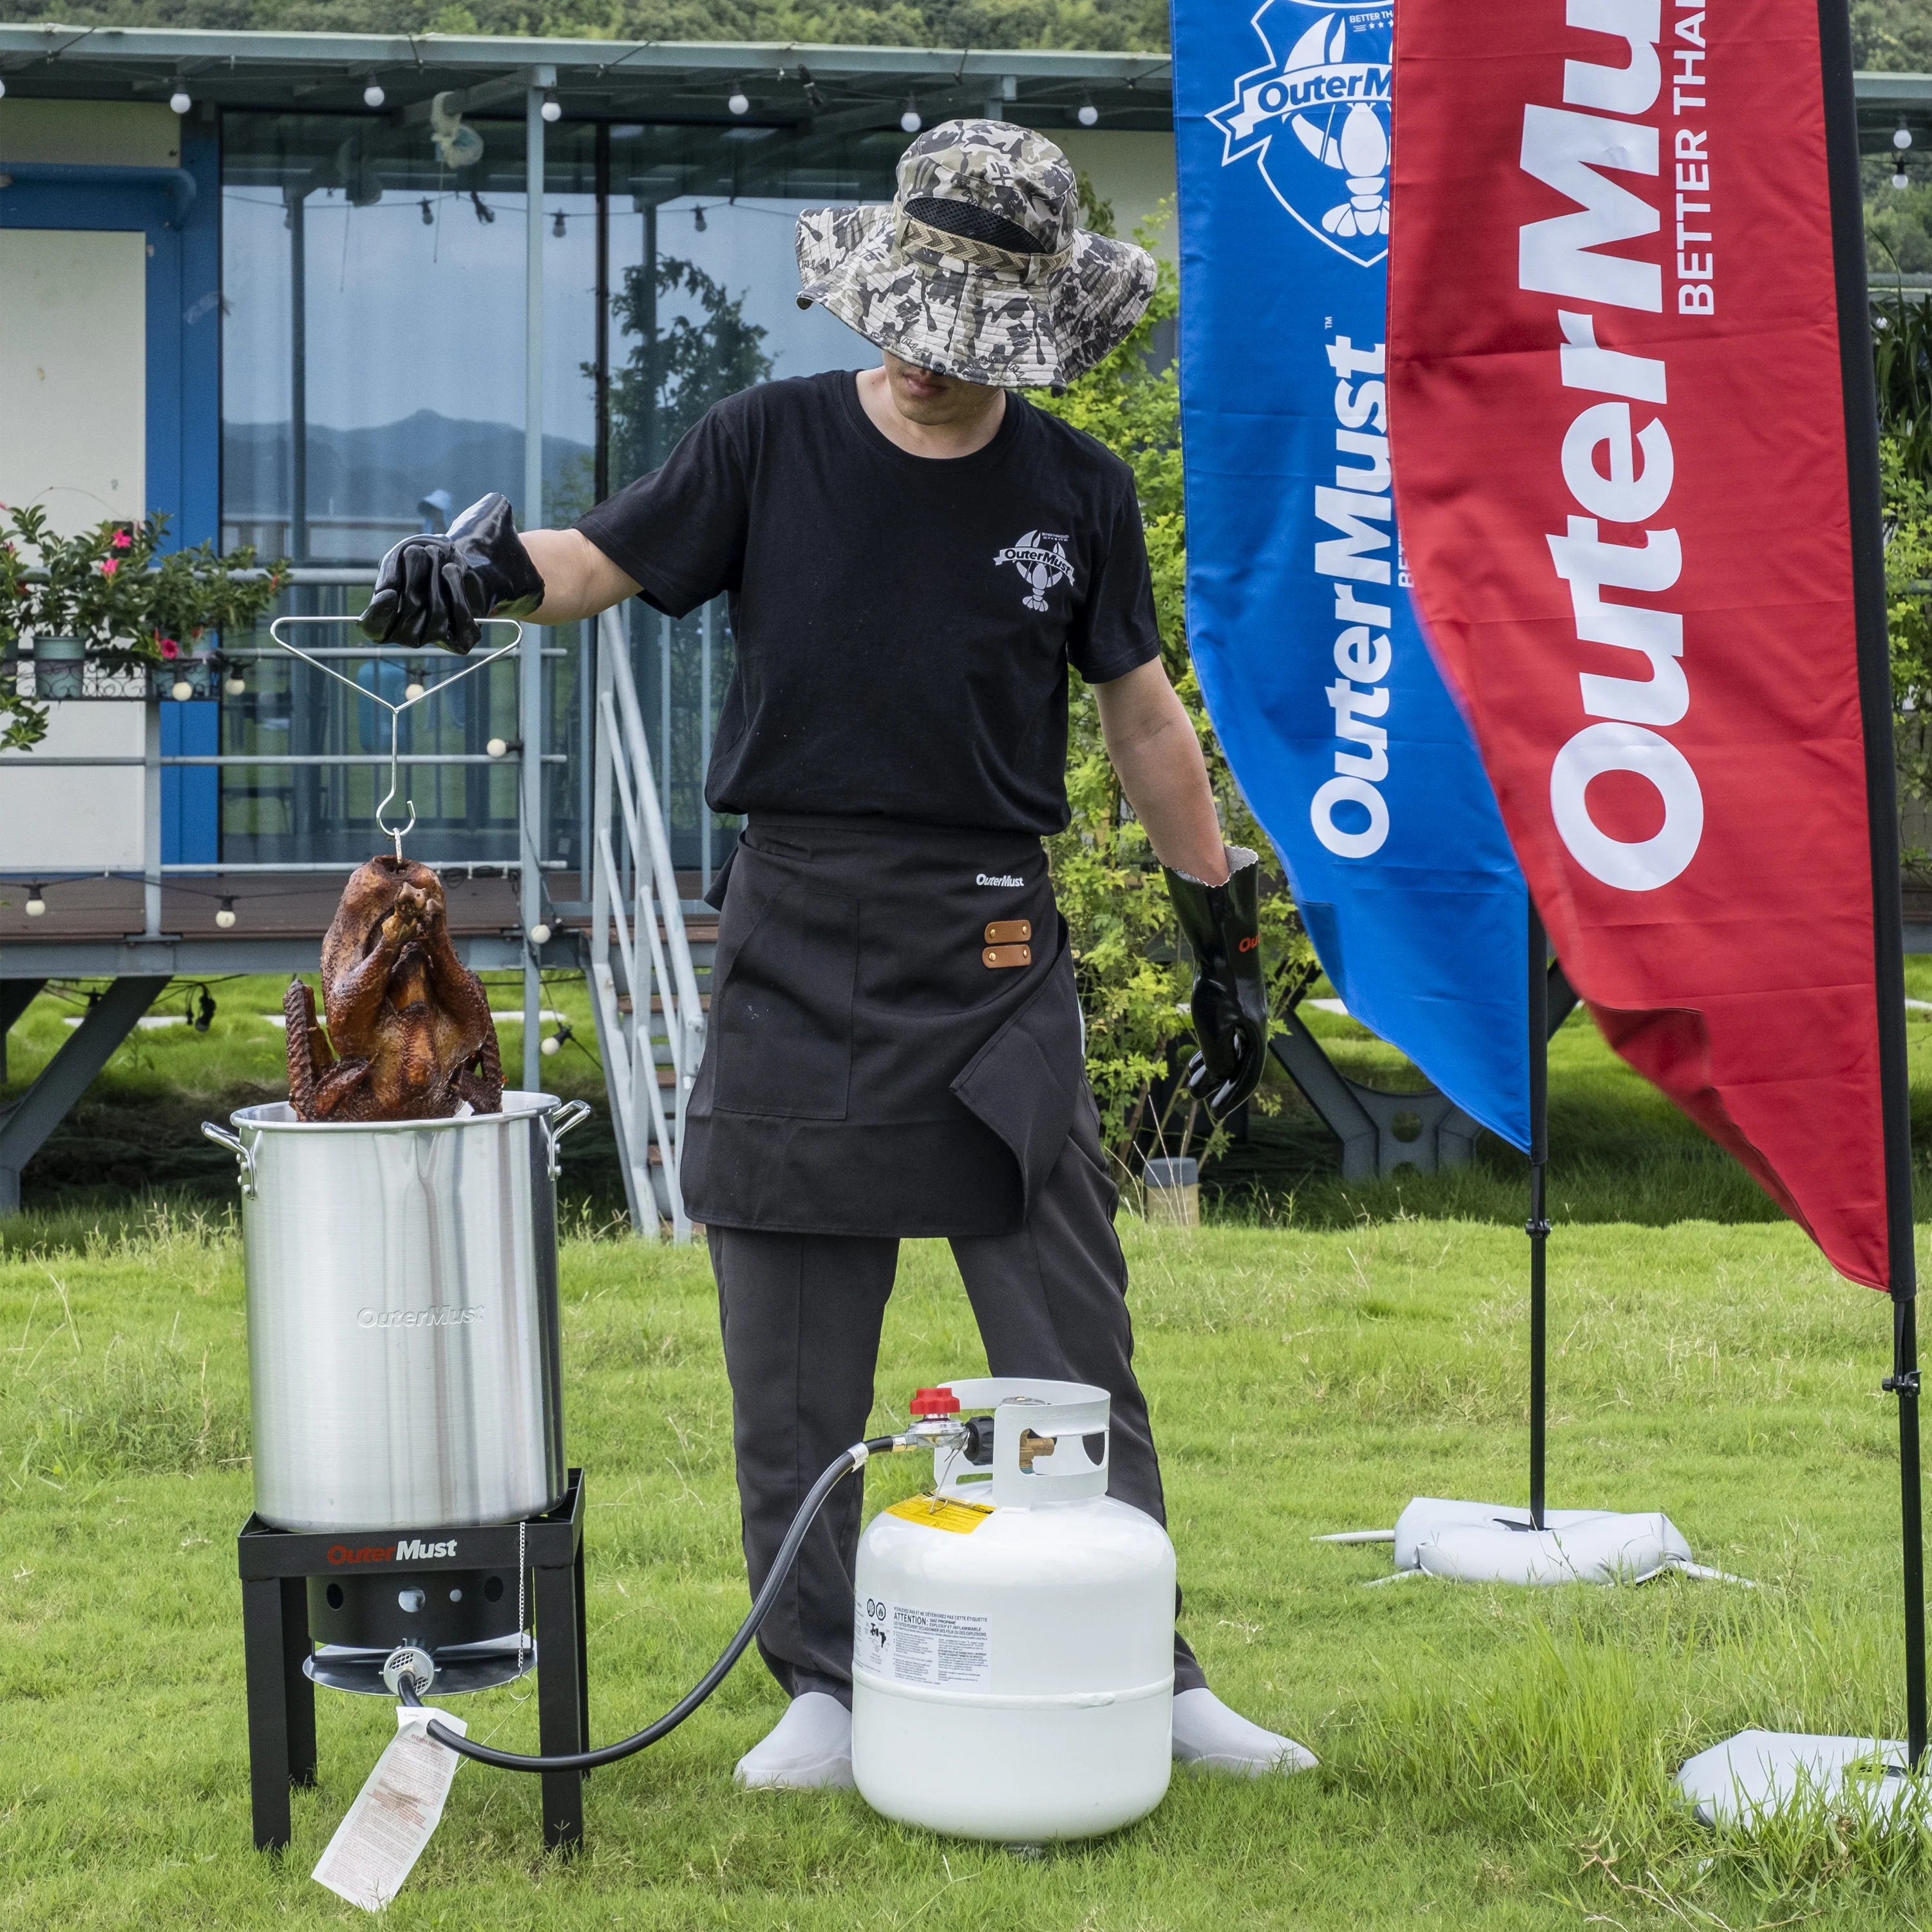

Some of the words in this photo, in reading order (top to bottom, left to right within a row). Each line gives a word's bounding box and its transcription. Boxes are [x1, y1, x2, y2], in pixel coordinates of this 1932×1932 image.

[1349, 12, 1381, 23] BETTER
[1674, 0, 1706, 115] THA
[1675, 129, 1714, 315] BETTER
[1004, 549, 1071, 575] OuterMust
[1311, 335, 1392, 858] OuterMust
[976, 873, 1025, 887] OuterMust
[357, 1304, 484, 1329] OuterMust
[327, 1539, 457, 1565] OuterMust
